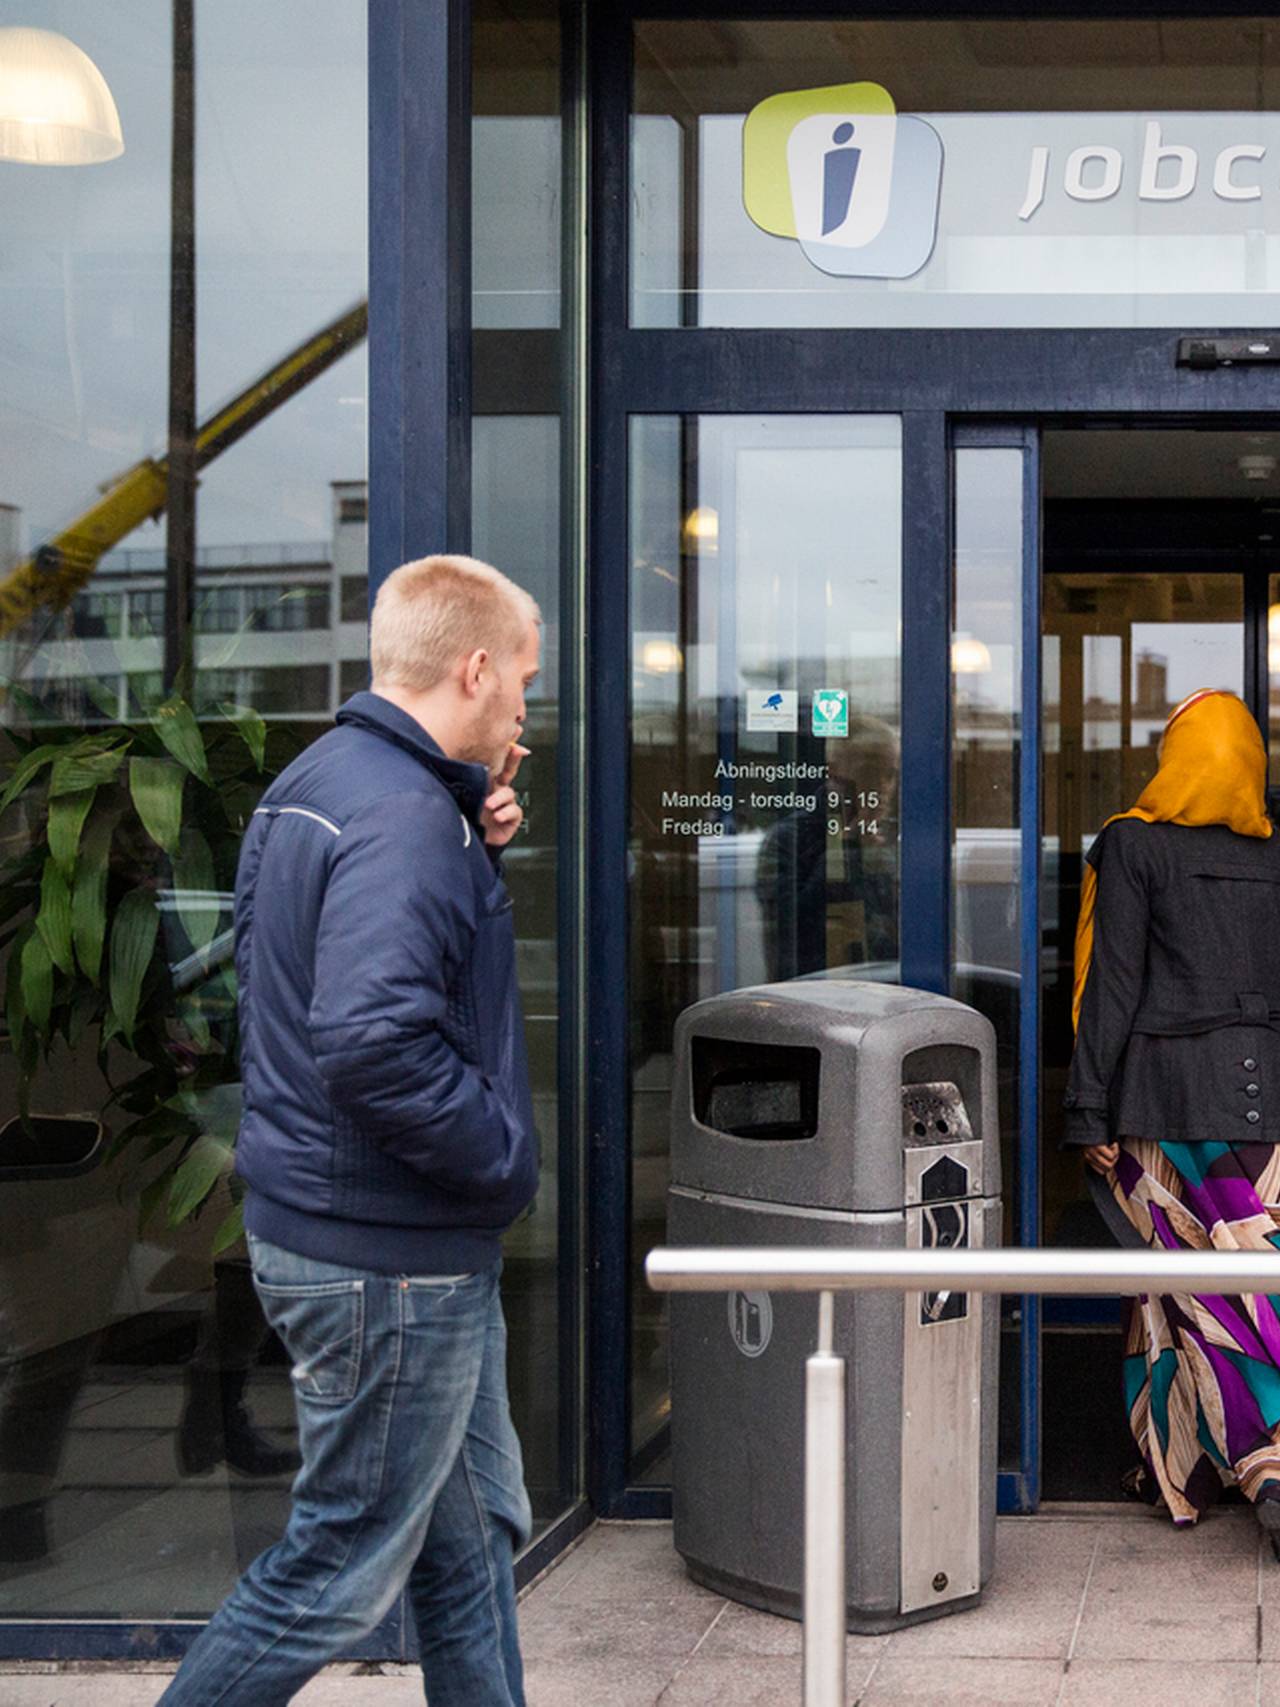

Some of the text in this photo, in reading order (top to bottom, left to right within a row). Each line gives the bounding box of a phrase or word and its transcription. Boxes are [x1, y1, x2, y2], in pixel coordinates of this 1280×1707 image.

[713, 759, 830, 782] Åbningstider:
[662, 791, 734, 812] Mandag
[750, 791, 817, 812] torsdag
[827, 791, 839, 808] 9
[857, 791, 879, 808] 15
[662, 818, 725, 839] Fredag
[827, 818, 839, 836] 9
[857, 818, 879, 836] 14
